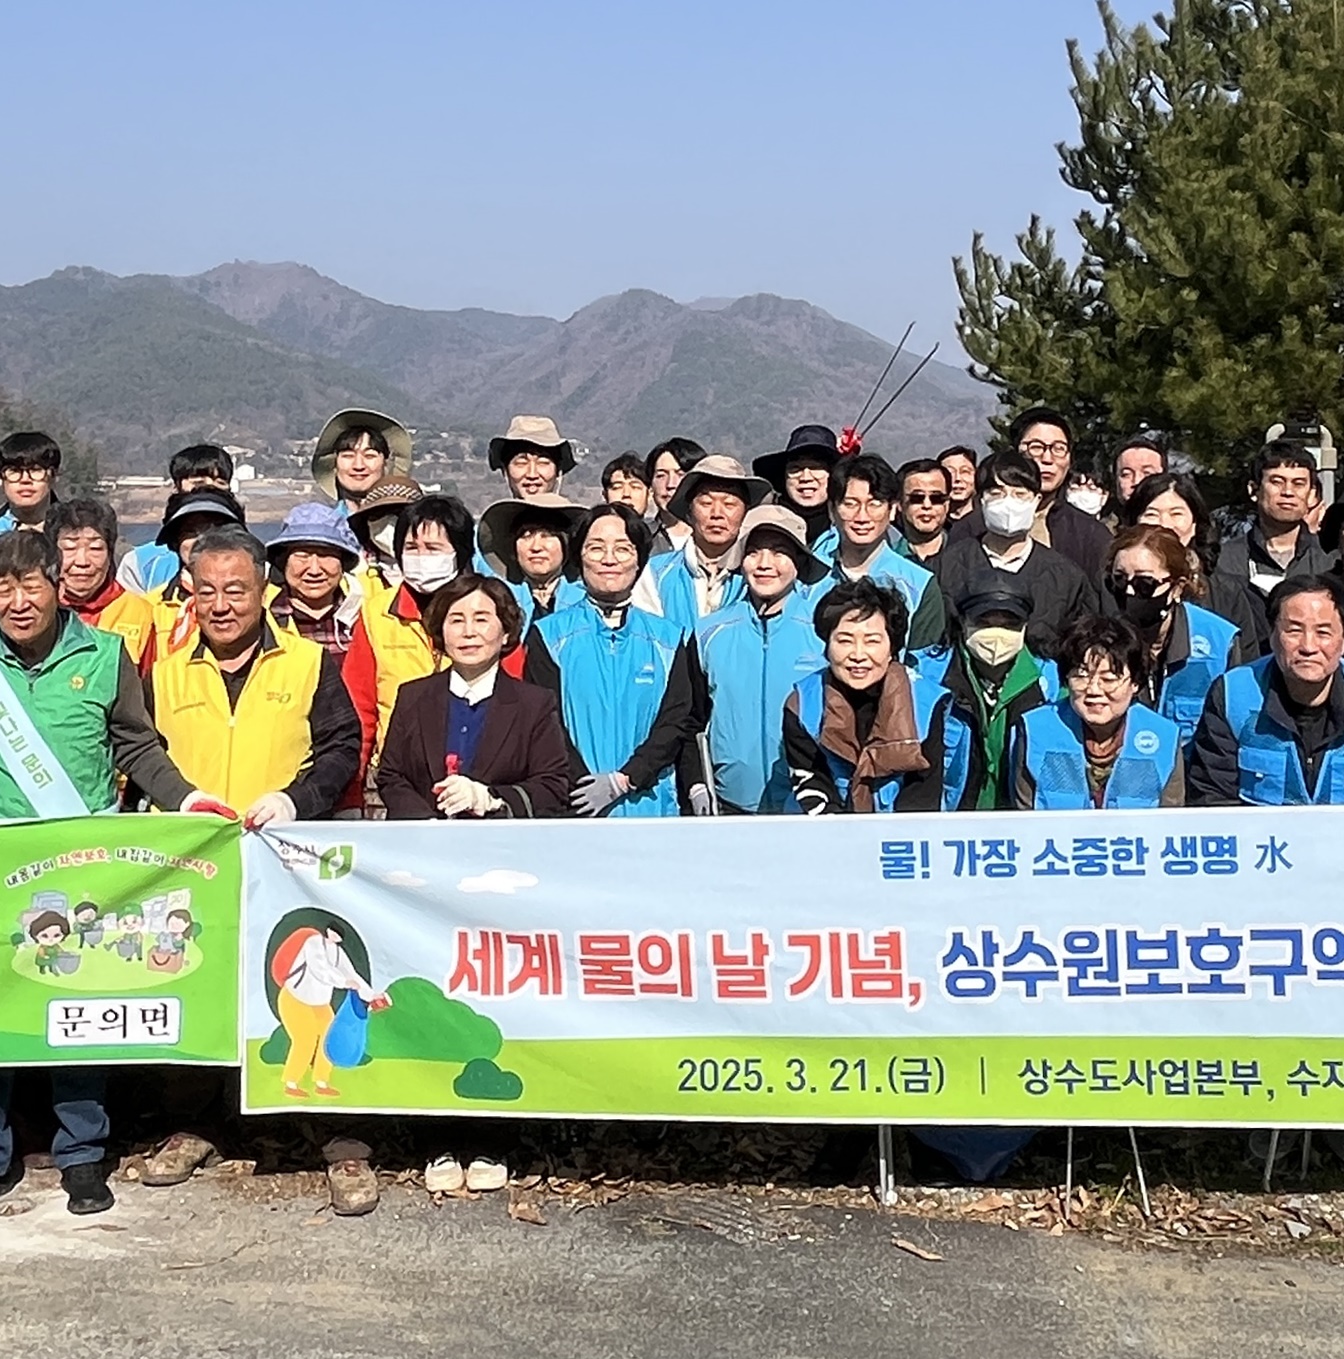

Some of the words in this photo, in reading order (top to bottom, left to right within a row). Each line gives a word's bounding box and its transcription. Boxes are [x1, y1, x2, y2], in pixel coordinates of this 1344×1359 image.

[879, 840, 931, 879] 물!
[943, 838, 1021, 878] 가장
[1032, 836, 1149, 877] 소중한
[1160, 835, 1238, 875] 생명
[1256, 835, 1294, 874] 水
[449, 930, 562, 996] 세계
[579, 933, 693, 997] 물의
[712, 932, 770, 998] 날
[787, 931, 921, 1008] 기념,
[57, 1002, 170, 1039] 문의면
[677, 1058, 774, 1093] 2025.
[785, 1058, 817, 1093] 3.
[829, 1056, 945, 1095] 21.(금)
[1017, 1057, 1275, 1102] 상수도사업본부,
